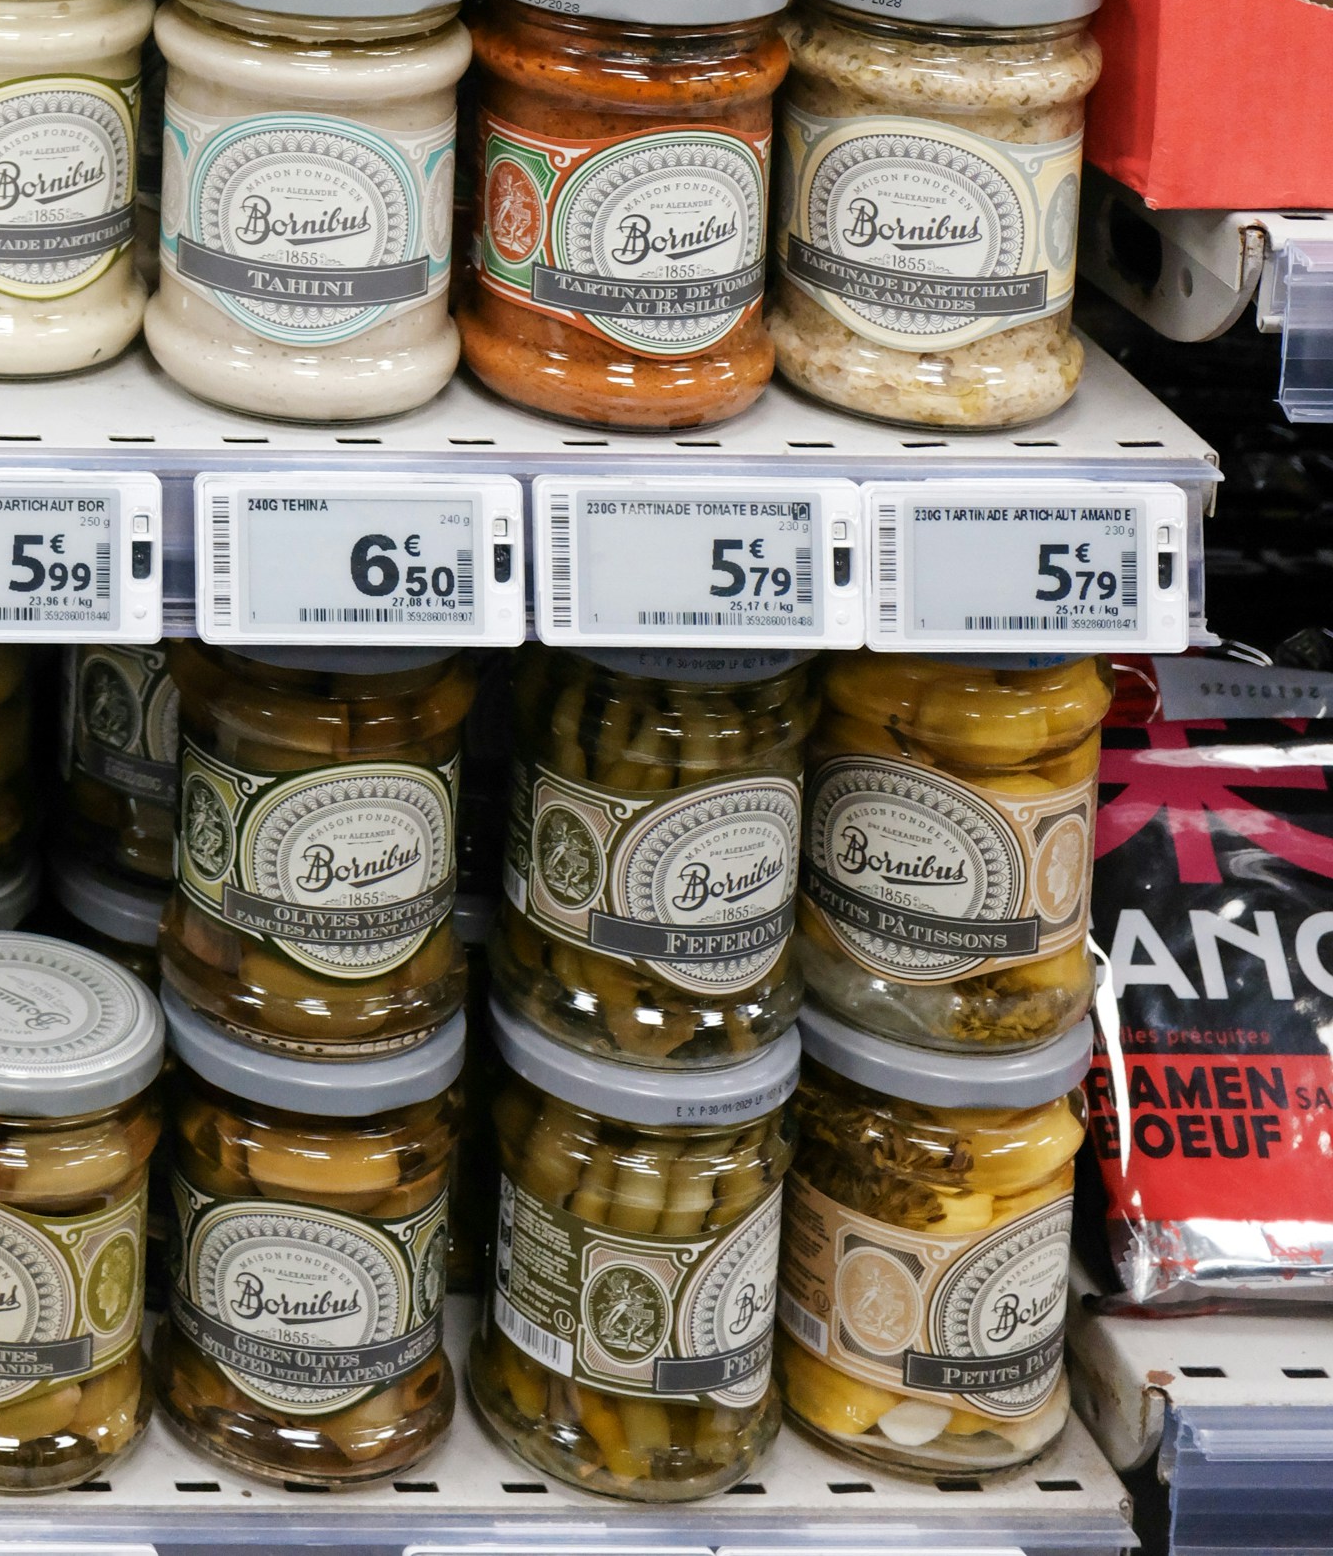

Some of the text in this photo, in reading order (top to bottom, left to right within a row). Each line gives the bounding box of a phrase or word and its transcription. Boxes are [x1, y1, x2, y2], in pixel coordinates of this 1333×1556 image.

[236, 195, 372, 245] Bornibus
[248, 271, 354, 296] TAHINI
[801, 246, 1030, 297] TARTINADE D'ARTICHAUT
[842, 280, 976, 311] AUX AMANDES
[248, 499, 328, 512] 240G TEHINA
[665, 917, 783, 954] FEFERONI
[876, 910, 1007, 950] PÂTISSONS
[1167, 1027, 1270, 1046] précuites
[231, 1272, 361, 1321] Bornibus
[201, 1332, 271, 1376] STUFFED
[232, 1335, 359, 1369] GREEN OLIVES
